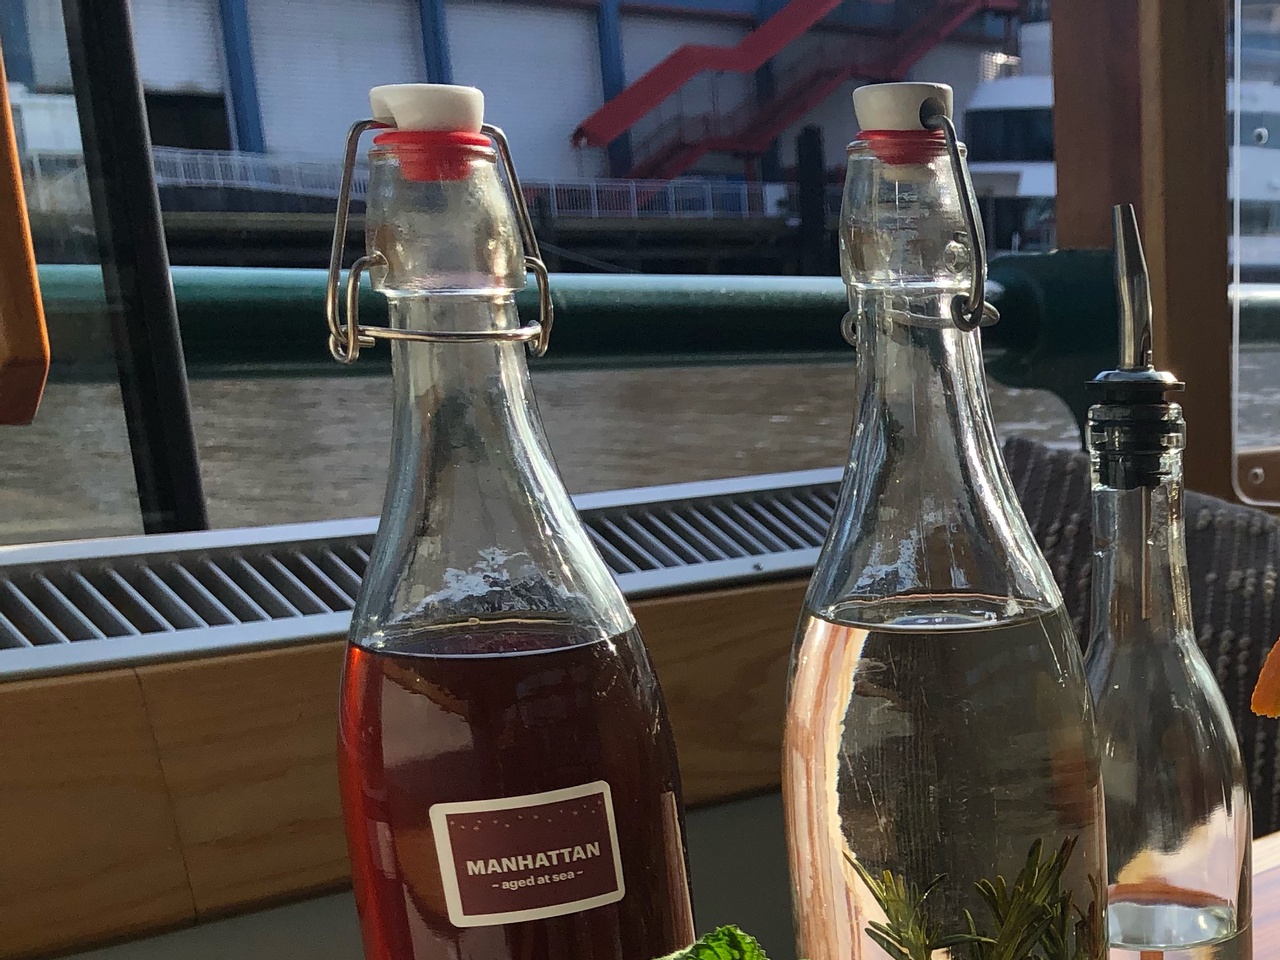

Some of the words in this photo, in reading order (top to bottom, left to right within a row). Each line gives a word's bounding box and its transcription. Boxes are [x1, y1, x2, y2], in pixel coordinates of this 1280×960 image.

[466, 841, 601, 876] MANHATTAN
[501, 875, 535, 891] aged
[537, 875, 551, 885] at
[552, 871, 575, 882] sea
